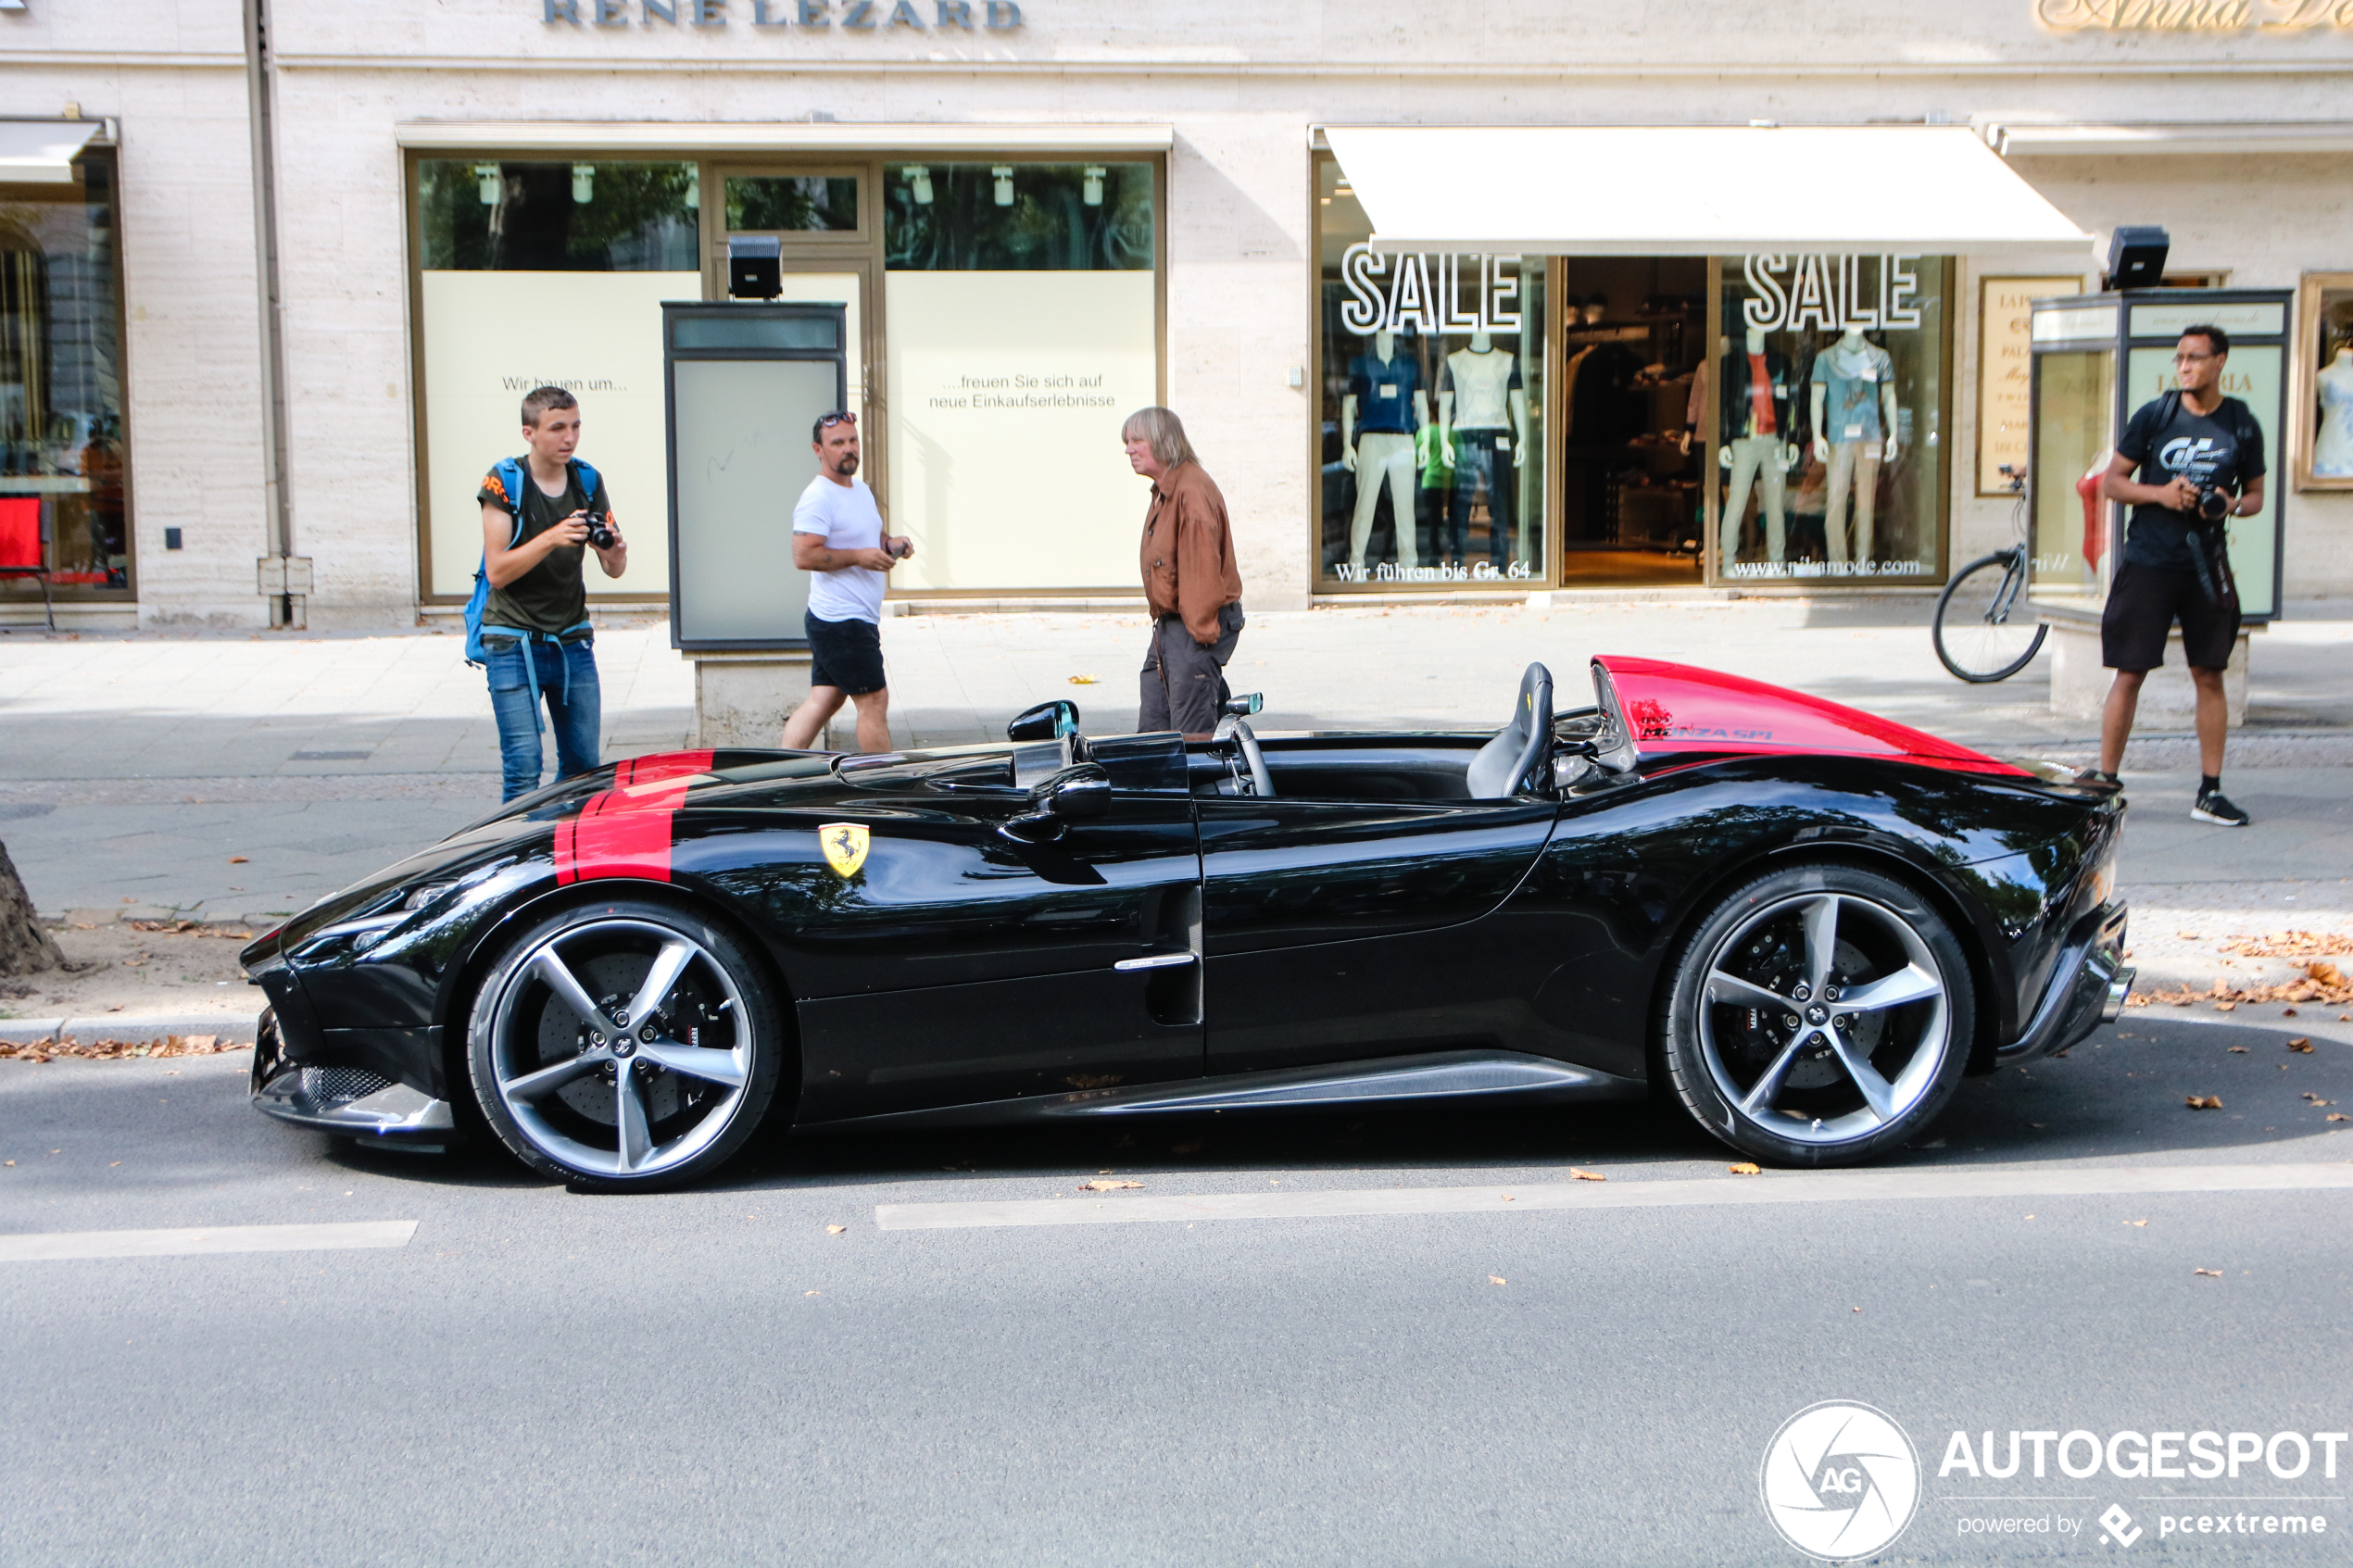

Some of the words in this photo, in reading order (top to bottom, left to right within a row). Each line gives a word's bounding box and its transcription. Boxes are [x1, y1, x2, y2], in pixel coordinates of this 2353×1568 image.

[749, 0, 1021, 28] LEZARD
[1340, 242, 1522, 335] SALE
[1743, 252, 1921, 332] SALE
[501, 376, 529, 391] Wir
[1014, 373, 1039, 388] Sie
[1044, 374, 1074, 388] sich
[1078, 373, 1103, 388] auf
[929, 396, 967, 408] neue
[973, 393, 1115, 408] Einkaufserlebnisse
[1335, 563, 1370, 582] Wir
[1376, 561, 1436, 581] führen
[1441, 561, 1468, 581] bis
[1507, 559, 1531, 581] 64
[1642, 727, 1729, 739] MONZA
